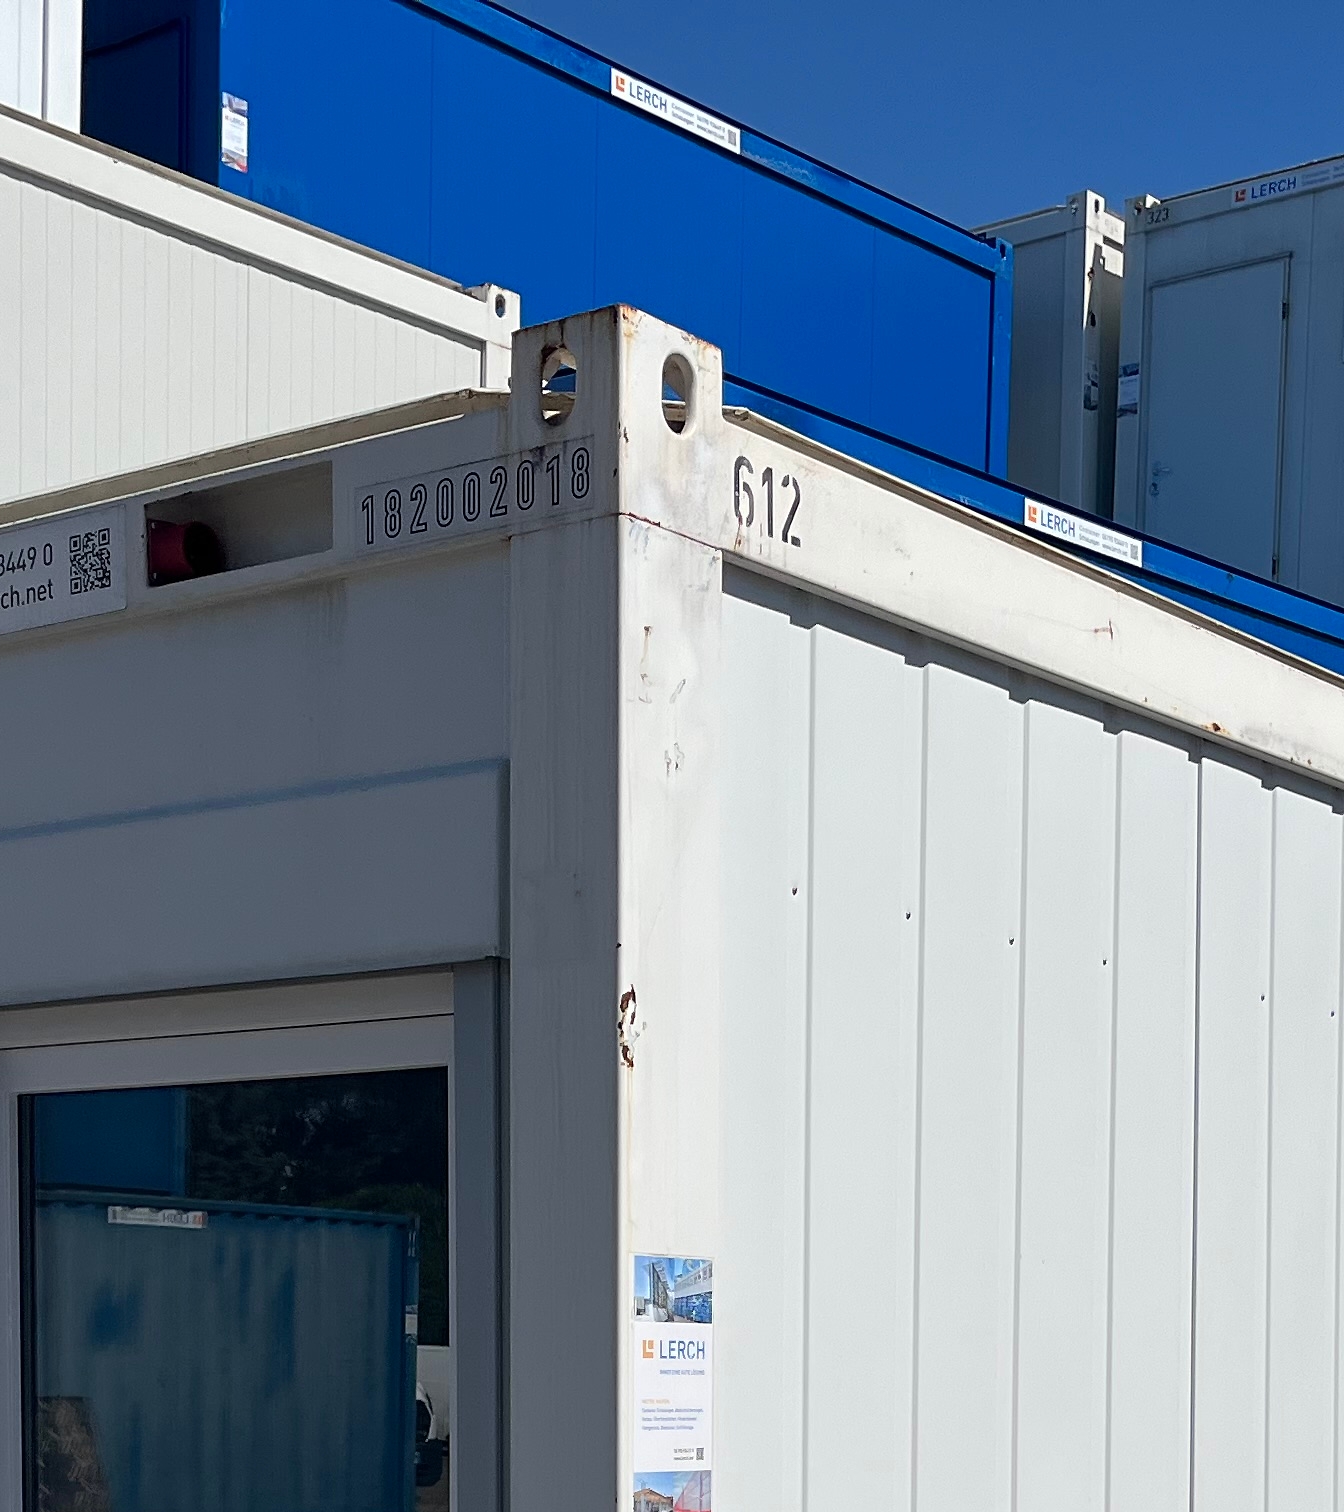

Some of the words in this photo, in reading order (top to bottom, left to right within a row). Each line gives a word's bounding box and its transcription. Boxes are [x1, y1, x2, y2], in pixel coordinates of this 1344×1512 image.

[629, 81, 668, 113] LERCH
[1251, 177, 1296, 199] LERCH
[361, 446, 590, 545] 182002018
[733, 455, 801, 548] 612
[1040, 509, 1076, 537] LERCH
[43, 542, 53, 566] 0
[659, 1340, 705, 1359] LERCH
